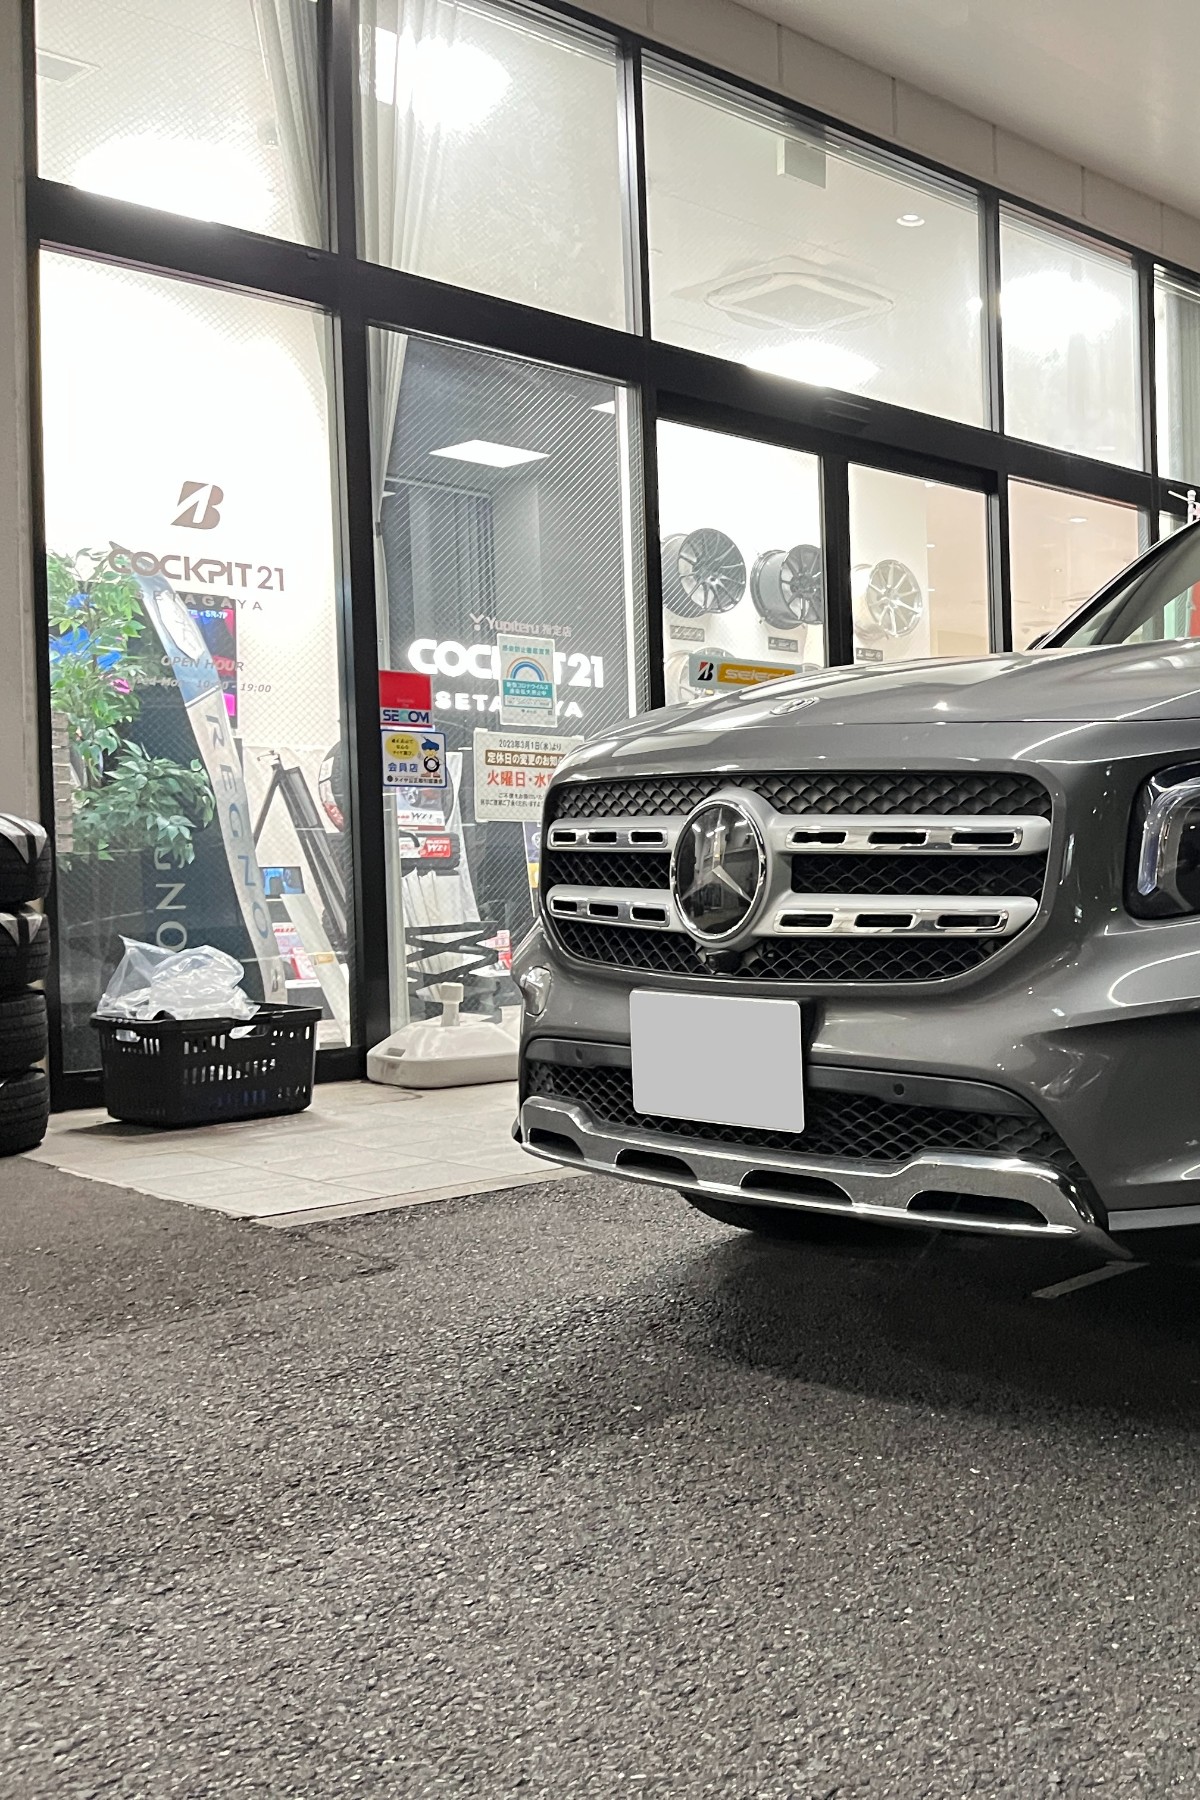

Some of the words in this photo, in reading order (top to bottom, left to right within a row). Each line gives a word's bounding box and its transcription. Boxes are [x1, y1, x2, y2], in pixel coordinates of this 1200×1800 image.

[135, 590, 263, 611] SETAGAYA
[486, 616, 539, 634] Yupiteru
[542, 623, 572, 637] 指定店
[161, 655, 200, 669] OPEN
[205, 660, 244, 672] HOUR
[241, 682, 272, 693] 19:00
[434, 691, 584, 718] SETAYA
[382, 709, 430, 724] SECOM
[388, 762, 418, 773] 会員店
[487, 769, 554, 788] 火曜日・水
[205, 715, 269, 938] REGNO
